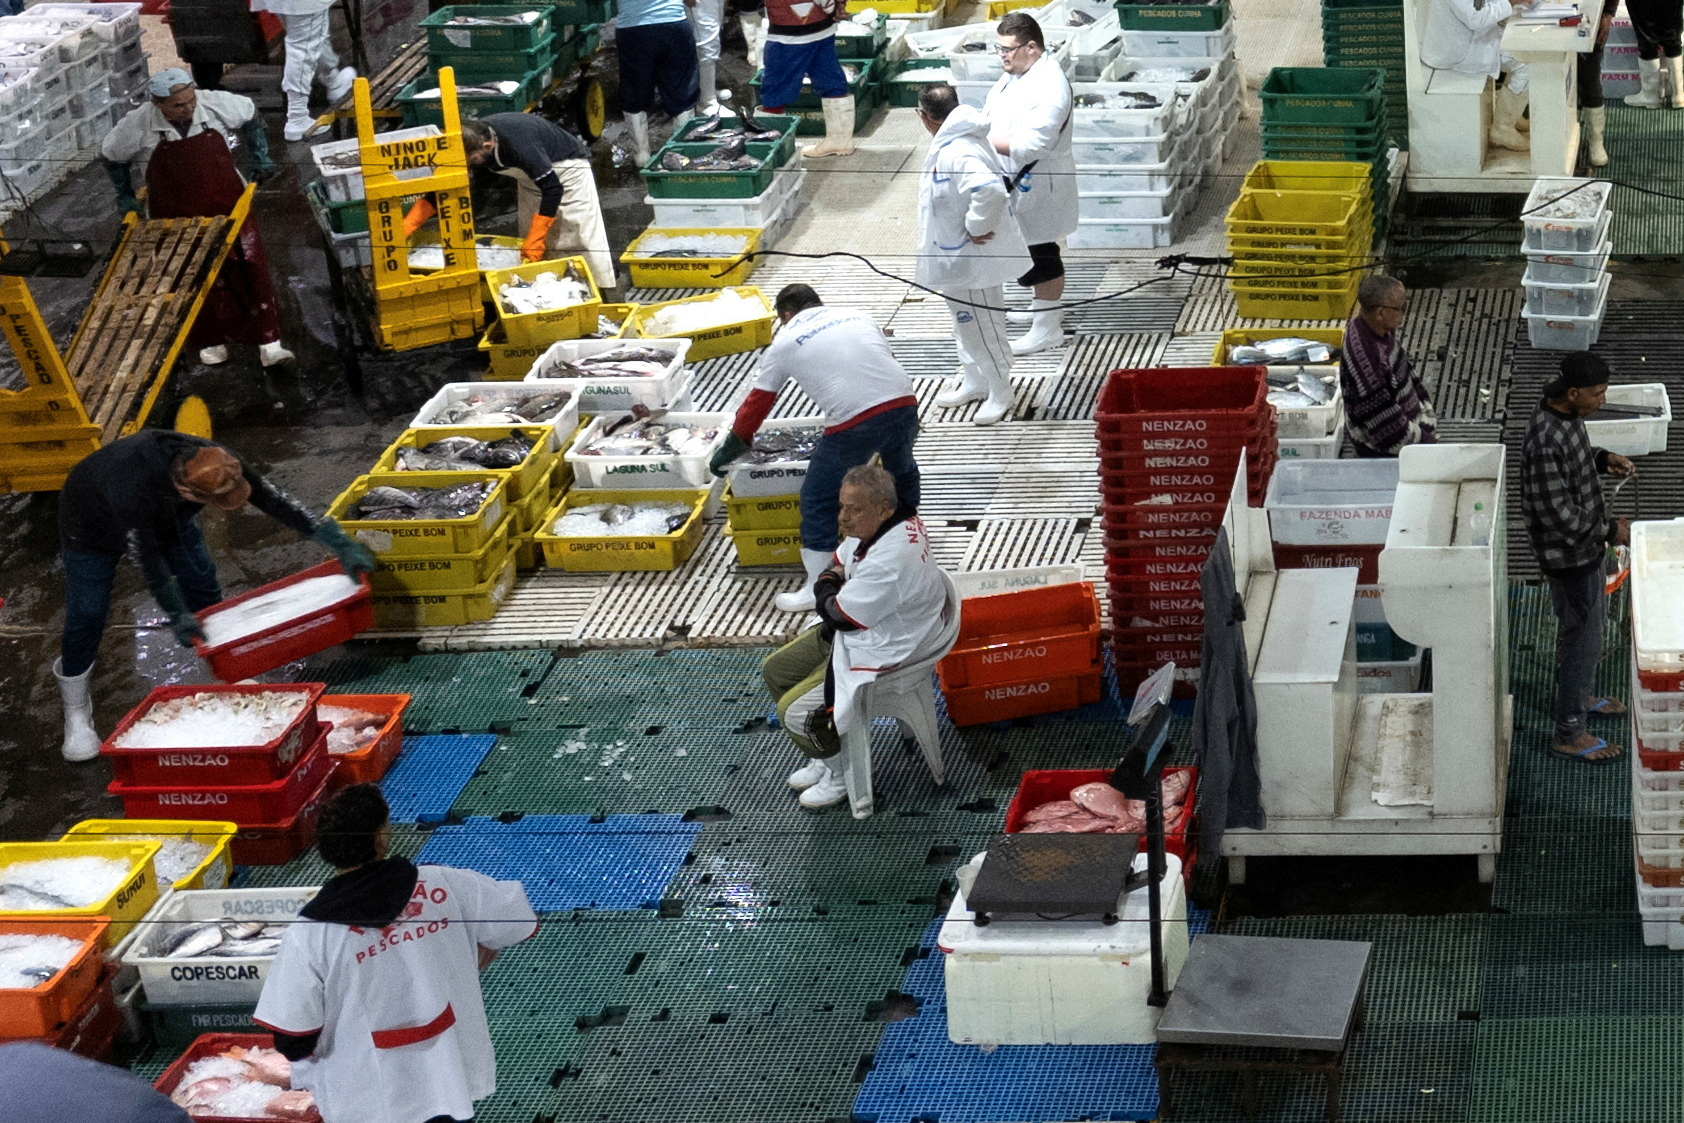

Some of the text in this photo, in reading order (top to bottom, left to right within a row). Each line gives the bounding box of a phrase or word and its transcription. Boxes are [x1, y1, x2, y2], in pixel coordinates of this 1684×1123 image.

[1138, 8, 1202, 18] PESCADOS CUNHA
[380, 136, 449, 158] NINO E
[388, 152, 438, 171] JACK
[458, 196, 474, 241] BOM
[438, 192, 456, 266] PEIXE
[1245, 226, 1316, 236] GRUPO PEIXE BOM
[378, 201, 398, 272] GRUPO
[638, 262, 709, 272] GRUPO PEIXE BOM
[1245, 266, 1316, 276] GRUPO PEIXE BOM
[1247, 280, 1318, 288] GRUPO PEIXE BOM
[1249, 292, 1320, 301] GRUPO PEIXE BOM
[723, 326, 743, 337] BOM
[503, 348, 536, 359] GRUPO
[1142, 420, 1207, 431] NENZAO
[1280, 447, 1300, 457] SUL
[1145, 455, 1209, 468] NENZAO
[605, 462, 670, 475] LAGUNA SUL
[749, 468, 807, 480] GRUPO PEIX
[1150, 474, 1214, 486] NENZAO
[757, 501, 792, 511] GRUPO
[1148, 511, 1212, 523] NENZAO
[1300, 509, 1392, 521] FAZENDA MAB
[424, 526, 447, 536] BOM
[1139, 528, 1217, 538] NENZA
[569, 540, 656, 552] GRUPO PEIXE BOM
[757, 537, 791, 546] GRUPO
[397, 561, 451, 572] PEIXE BOM
[1302, 553, 1333, 568] Nutri
[1149, 580, 1202, 591] NENZA
[981, 645, 1047, 666] NENZAO
[1156, 650, 1187, 662] DELTA
[984, 682, 1051, 700] NENZAO
[158, 754, 229, 767] NENZAO
[158, 792, 229, 805] NENZAO
[355, 917, 450, 965] PESCADOS
[170, 965, 260, 982] COPESCAR
[211, 1014, 258, 1027] PESCADO
